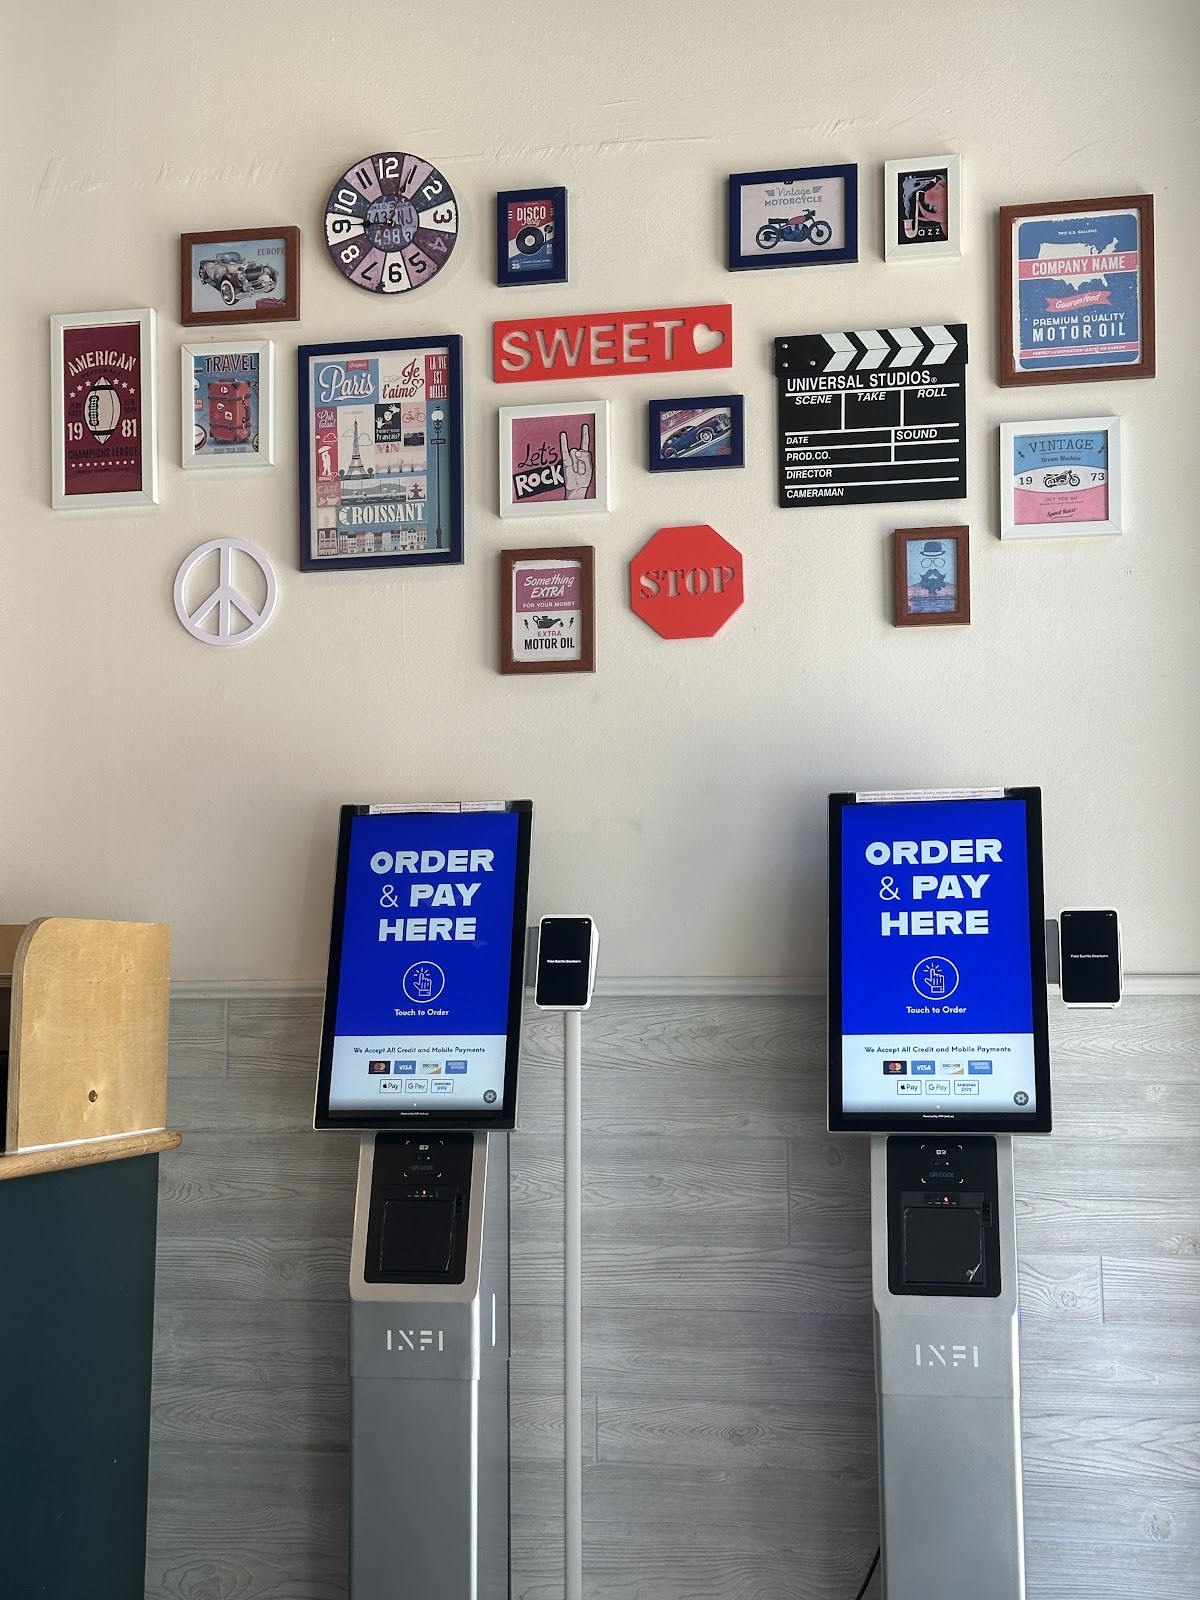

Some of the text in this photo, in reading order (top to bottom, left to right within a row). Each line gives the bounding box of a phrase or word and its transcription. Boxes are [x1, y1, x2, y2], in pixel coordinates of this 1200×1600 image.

[379, 157, 400, 179] 12
[422, 180, 443, 201] 2
[776, 187, 811, 199] Vintage
[334, 188, 358, 214] 10
[765, 196, 822, 207] MOTORCYCLE
[433, 209, 453, 224] 3
[517, 206, 546, 221] DISCO
[332, 219, 352, 234] 9
[257, 247, 286, 256] EUROPE
[428, 236, 448, 253] 4
[340, 244, 360, 264] 8
[408, 252, 427, 274] 5
[1032, 256, 1126, 276] COMPANY NAME
[361, 261, 378, 281] 7
[388, 263, 402, 283] 6
[1055, 292, 1101, 309] Guaranteed
[1033, 312, 1125, 327] PREMIUM QUALITY
[1032, 321, 1126, 343] MOTOR OIL
[501, 319, 686, 372] SWEET
[68, 350, 137, 377] AMERICAN
[204, 353, 258, 374] TRAVEL
[429, 355, 447, 370] LA VIE
[401, 358, 420, 385] Je
[433, 370, 443, 385] EST
[319, 365, 375, 403] Paris
[787, 374, 864, 392] UNIVERSAL
[795, 394, 832, 406] SCENE
[857, 391, 887, 402] TAKE
[916, 388, 947, 398] ROLL
[67, 418, 137, 441] 19 81
[896, 429, 938, 440] SOUND
[786, 436, 809, 445] DATE
[1029, 438, 1094, 453] VINTAGE
[68, 446, 138, 460] CHAMPIONS LEAGUE
[518, 442, 558, 468] Let's
[786, 451, 831, 461] PROD.CO.
[515, 464, 565, 496] ROCK
[786, 469, 832, 480] DIRECTOR
[1019, 472, 1105, 485] 19 73
[786, 488, 844, 499] CAMERAMAN
[524, 573, 575, 588] Something
[640, 566, 736, 599] STOP
[531, 585, 565, 599] EXTRA
[524, 637, 575, 650] MOTOR OIL
[865, 838, 1003, 866] ORDER
[370, 848, 495, 875] ORDER
[879, 874, 991, 901] & PAY
[379, 883, 482, 908] & PAY
[378, 917, 477, 942] HERE
[881, 910, 989, 936] HERE
[394, 1008, 416, 1016] Touch
[427, 1008, 449, 1016] Order
[906, 1005, 967, 1014] Touch to Order
[455, 1046, 486, 1054] Payments
[876, 1046, 900, 1054] Accept
[388, 1083, 399, 1091] Pay
[415, 1083, 426, 1091] Pay
[906, 1083, 918, 1091] Pay
[936, 1083, 947, 1091] Pay
